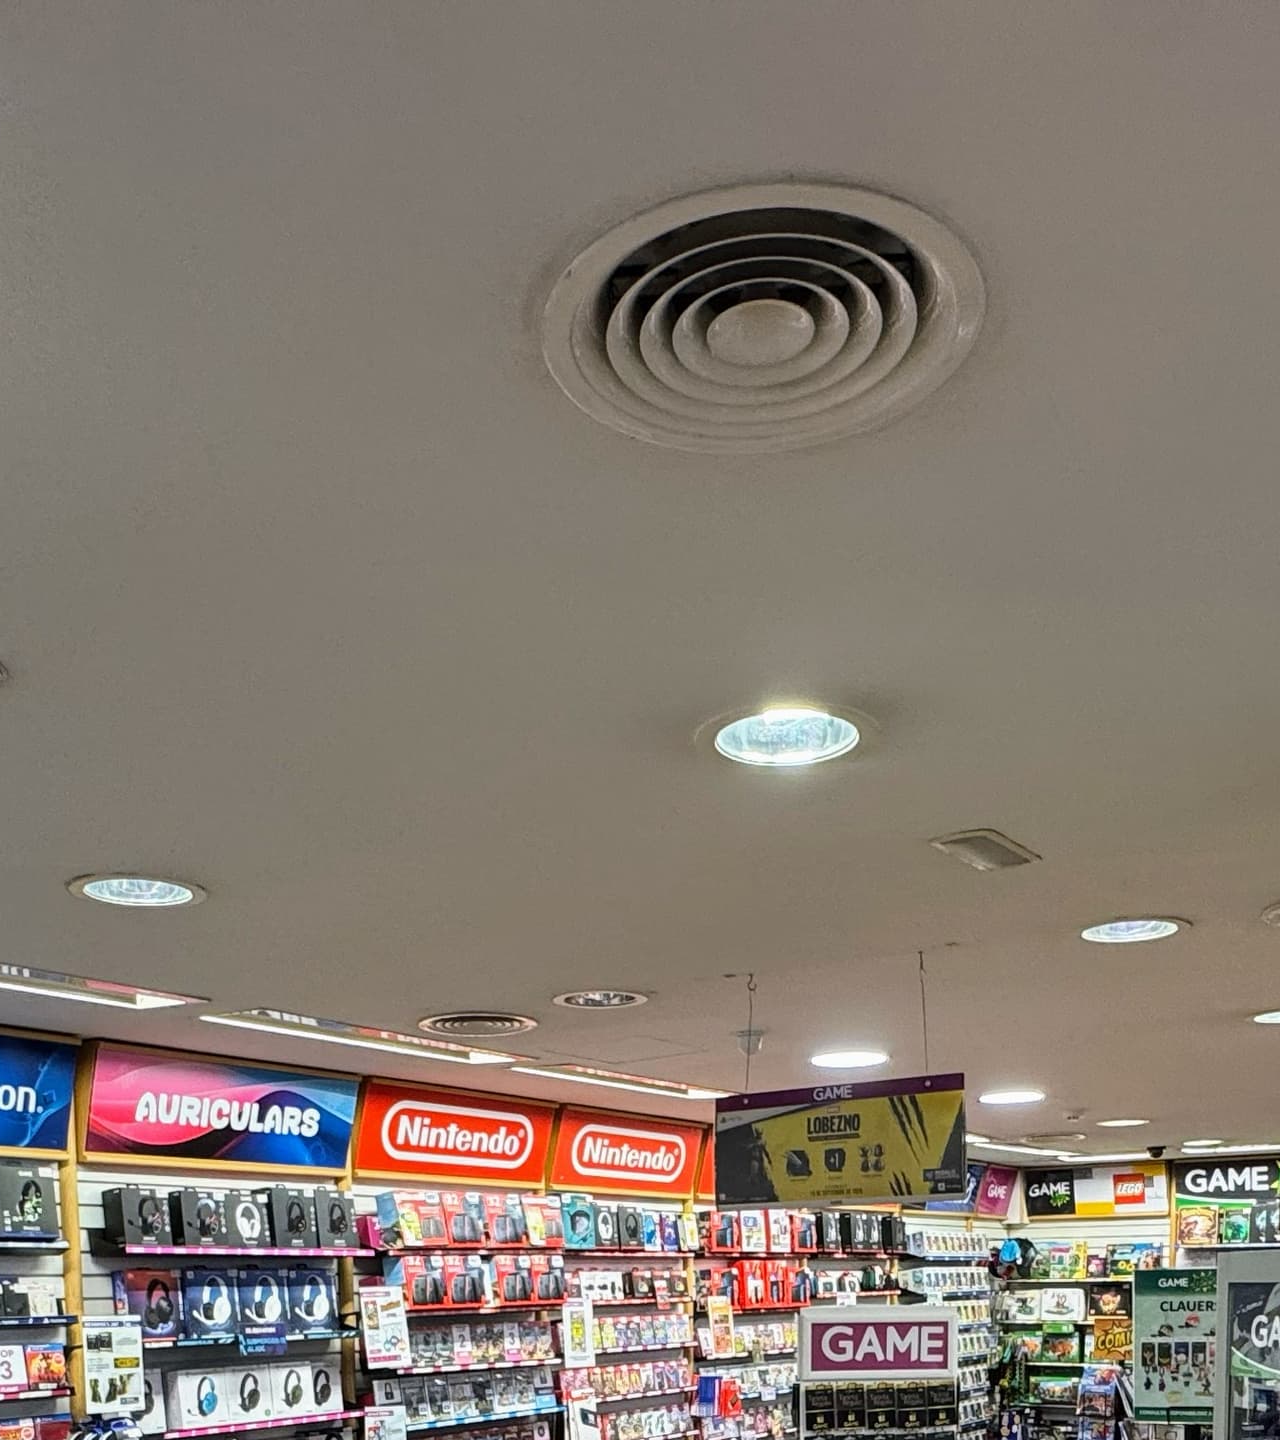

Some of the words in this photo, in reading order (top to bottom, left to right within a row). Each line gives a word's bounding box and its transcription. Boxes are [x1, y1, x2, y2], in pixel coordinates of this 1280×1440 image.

[813, 1085, 853, 1101] GAME
[135, 1092, 320, 1137] AURICULARS
[807, 1114, 860, 1134] LOBEZNO
[397, 1116, 520, 1157] Nintendo
[581, 1135, 676, 1174] Nintendo
[1185, 1166, 1269, 1192] GAME
[987, 1184, 1008, 1199] GAME
[1029, 1182, 1070, 1197] GAME
[1117, 1184, 1143, 1195] LEGO
[1158, 1278, 1189, 1288] GAME
[821, 1326, 944, 1362] GAME
[0, 1361, 14, 1380] 3
